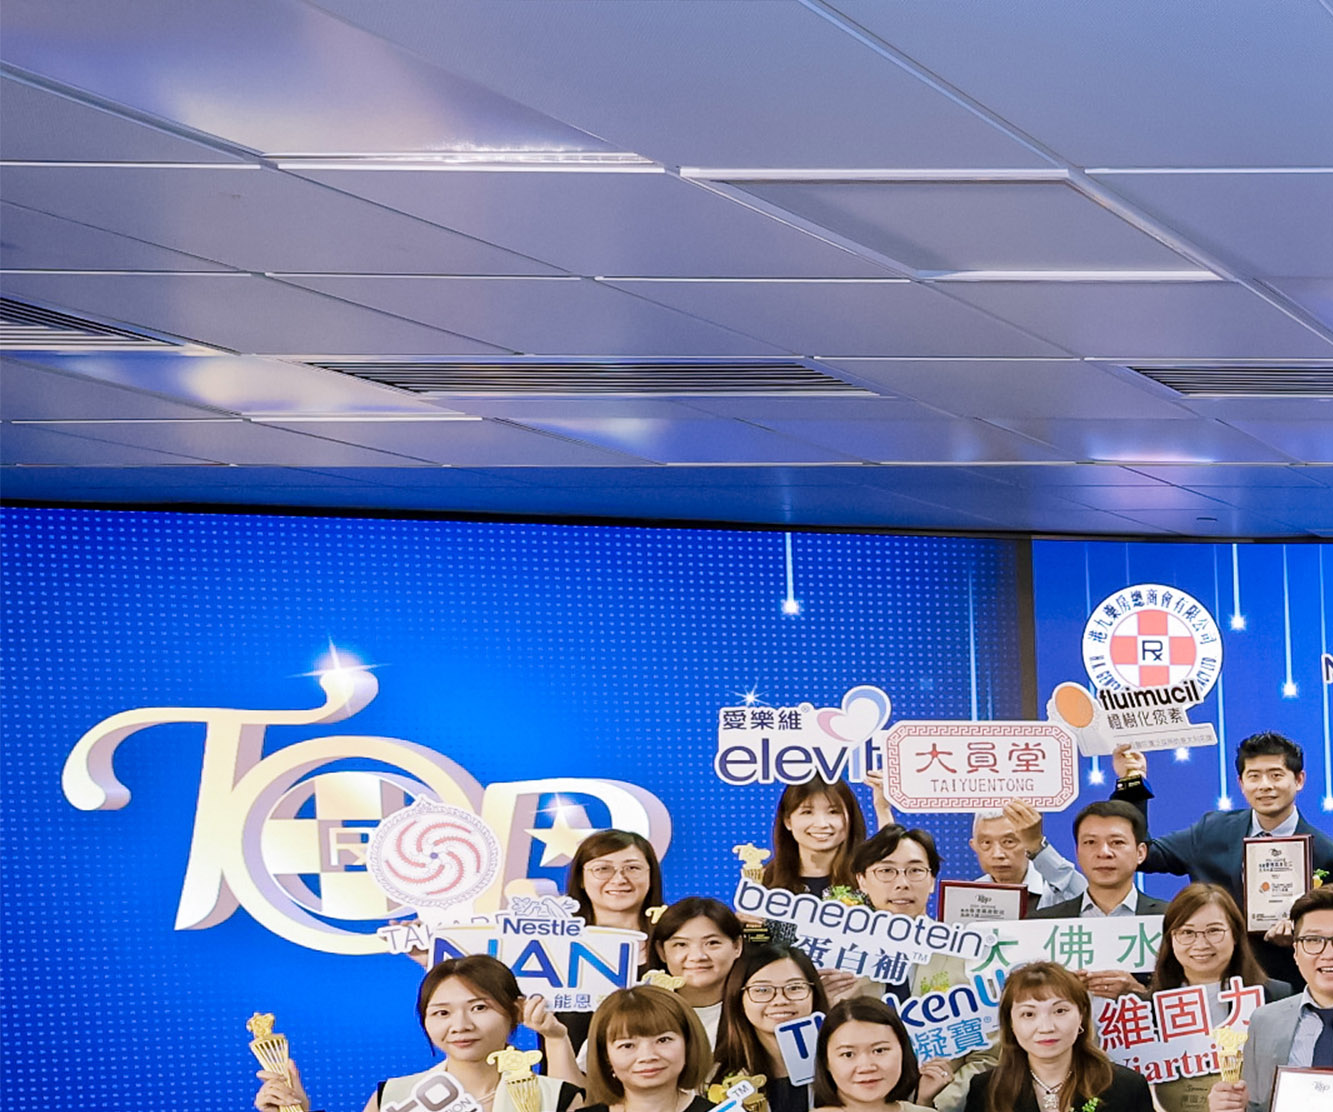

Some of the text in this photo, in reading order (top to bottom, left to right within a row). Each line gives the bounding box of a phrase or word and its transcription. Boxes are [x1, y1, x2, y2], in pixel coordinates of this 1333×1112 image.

[1100, 680, 1201, 711] fluimucil
[722, 709, 803, 731] 愛樂維
[718, 737, 881, 782] elevit
[915, 741, 1046, 774] 大員堂
[737, 880, 982, 958] beneprotein
[553, 993, 592, 1010] 能恩
[1098, 978, 1263, 1051] 維固力
